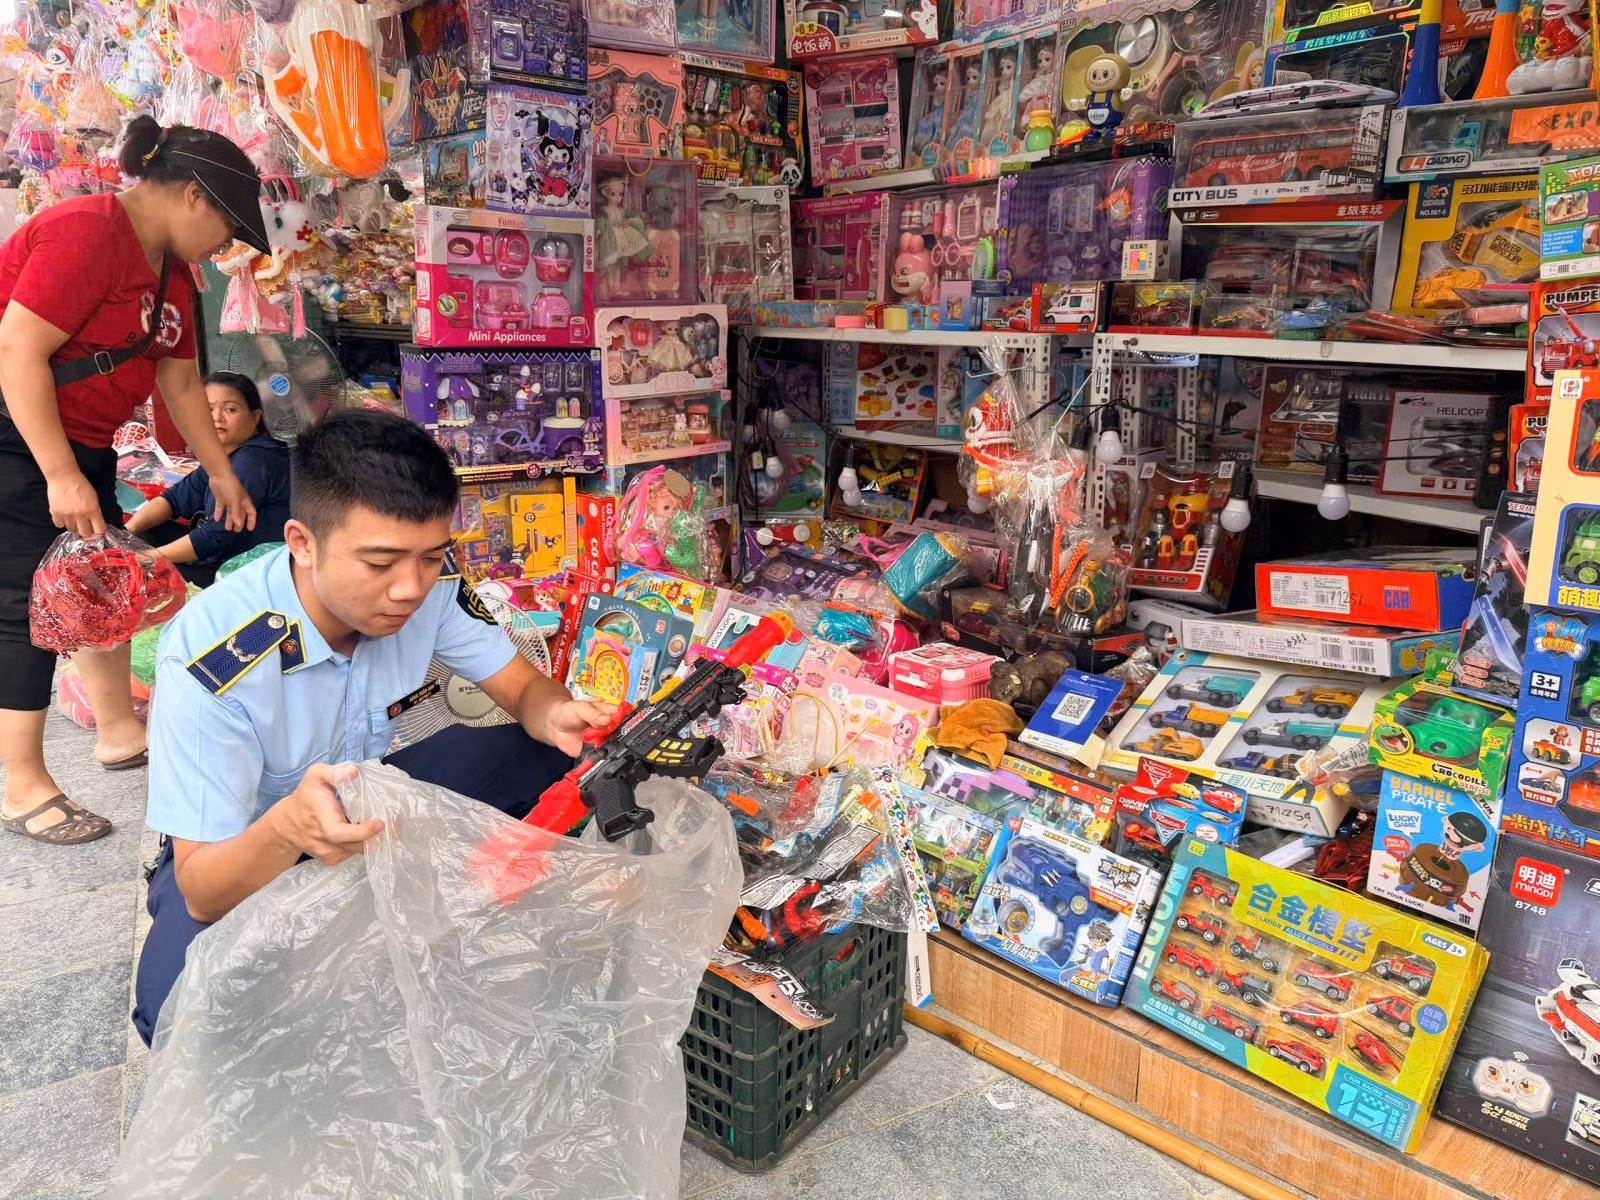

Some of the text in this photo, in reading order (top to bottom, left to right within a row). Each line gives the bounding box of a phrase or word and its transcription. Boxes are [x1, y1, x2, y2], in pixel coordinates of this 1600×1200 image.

[792, 36, 832, 53] 电饭锅
[1551, 110, 1600, 130] EXP
[1172, 189, 1205, 203] CITY
[1206, 188, 1238, 200] BUS
[468, 331, 547, 344] Mini Appliances
[1384, 590, 1411, 609] CAR
[1534, 675, 1556, 688] 3+
[1217, 770, 1285, 794] 工程小天地
[1431, 763, 1488, 787] CROCODILE
[1391, 776, 1455, 806] BARREL
[1391, 789, 1448, 815] PIRATE
[1388, 813, 1420, 823] LUCKY
[1518, 864, 1557, 891] 明迪
[1373, 886, 1424, 908] TRY YOUR LUCK!
[1514, 900, 1547, 916] 8748
[1132, 862, 1188, 981] MODEL
[1248, 882, 1373, 955] 合金模型
[1425, 935, 1464, 955] AGES 3+
[1500, 1114, 1528, 1132] CONTROL
[1504, 1108, 1531, 1124] REMOTE
